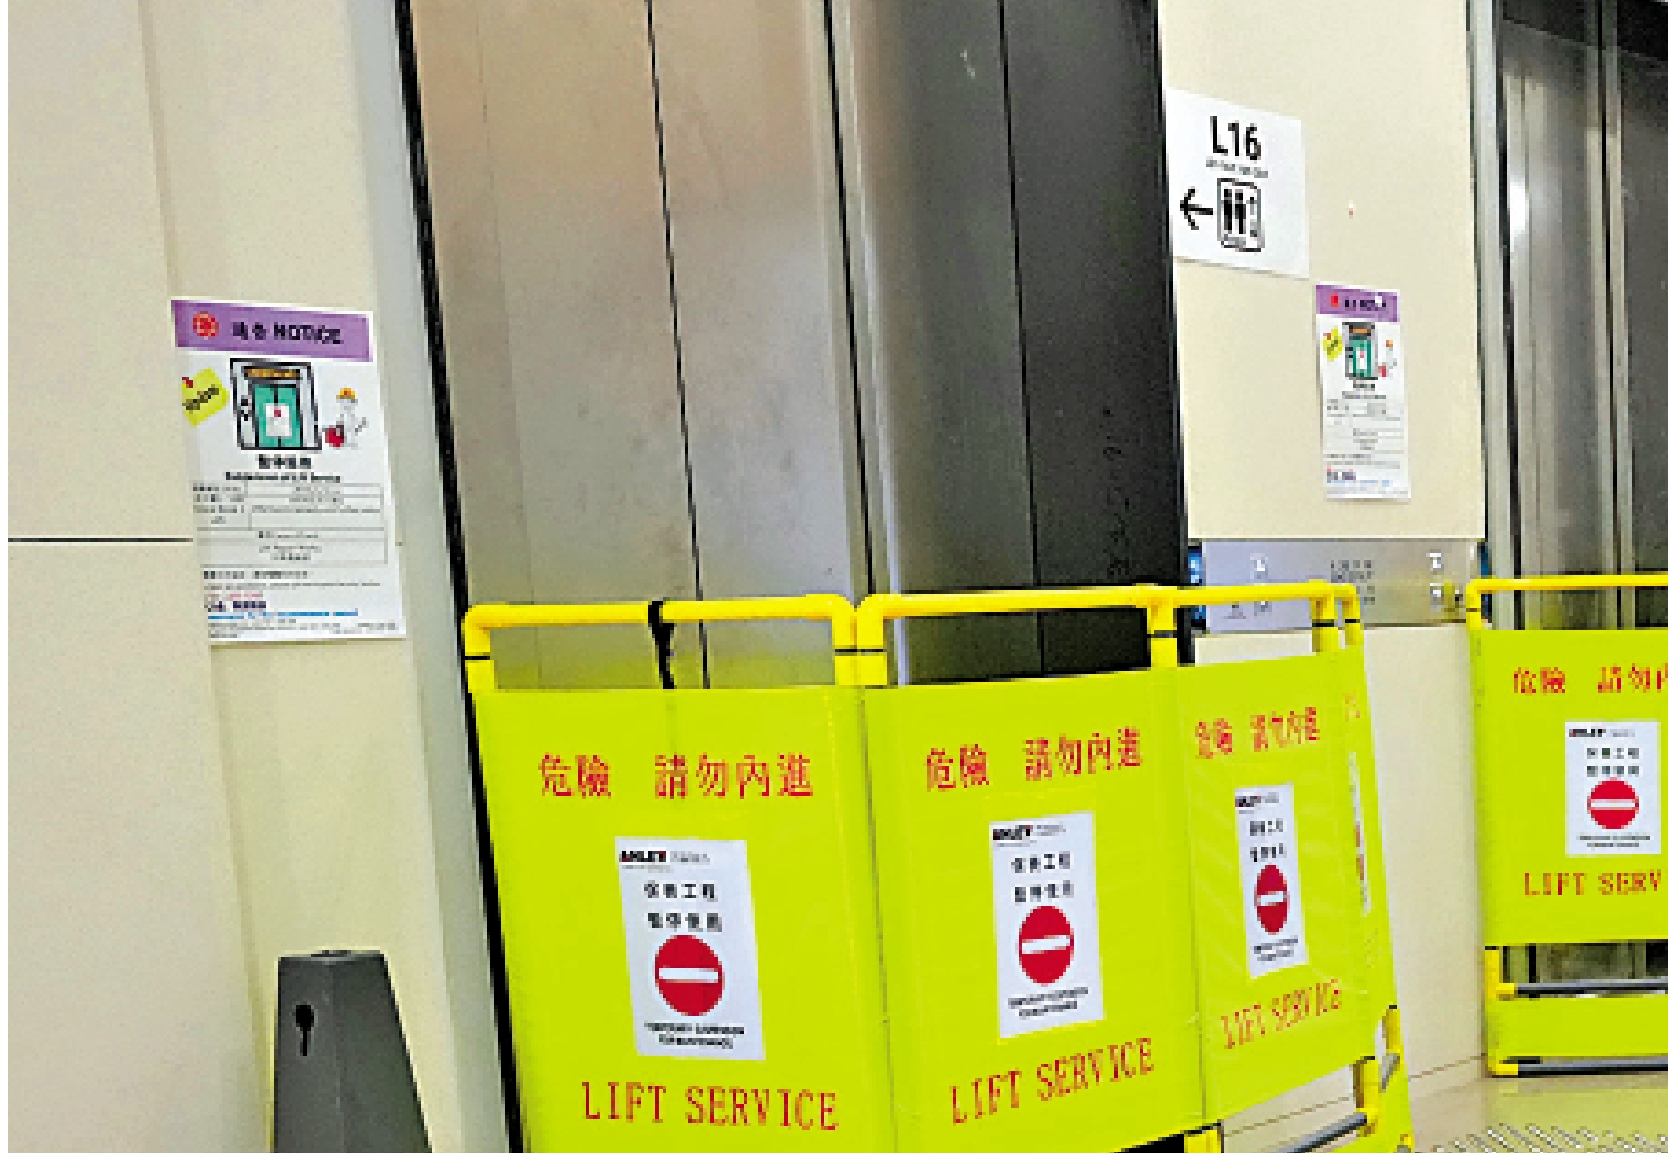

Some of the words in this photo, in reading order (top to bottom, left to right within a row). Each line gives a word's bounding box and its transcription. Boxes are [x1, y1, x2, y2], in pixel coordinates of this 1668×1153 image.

[1210, 115, 1262, 161] L16
[274, 322, 340, 344] NOTICE
[1514, 667, 1565, 693] 危險
[1195, 718, 1232, 759] 危險
[538, 753, 611, 799] 危險
[927, 744, 989, 792] 危險
[1525, 873, 1584, 895] LIFT
[1221, 1005, 1265, 1049] LIFT
[1272, 979, 1341, 1031] SERVICE
[952, 1070, 1022, 1124] LIFT
[1037, 1038, 1154, 1101] SERVICE
[582, 1082, 666, 1123] LIFT
[685, 1086, 839, 1130] SERVICE
